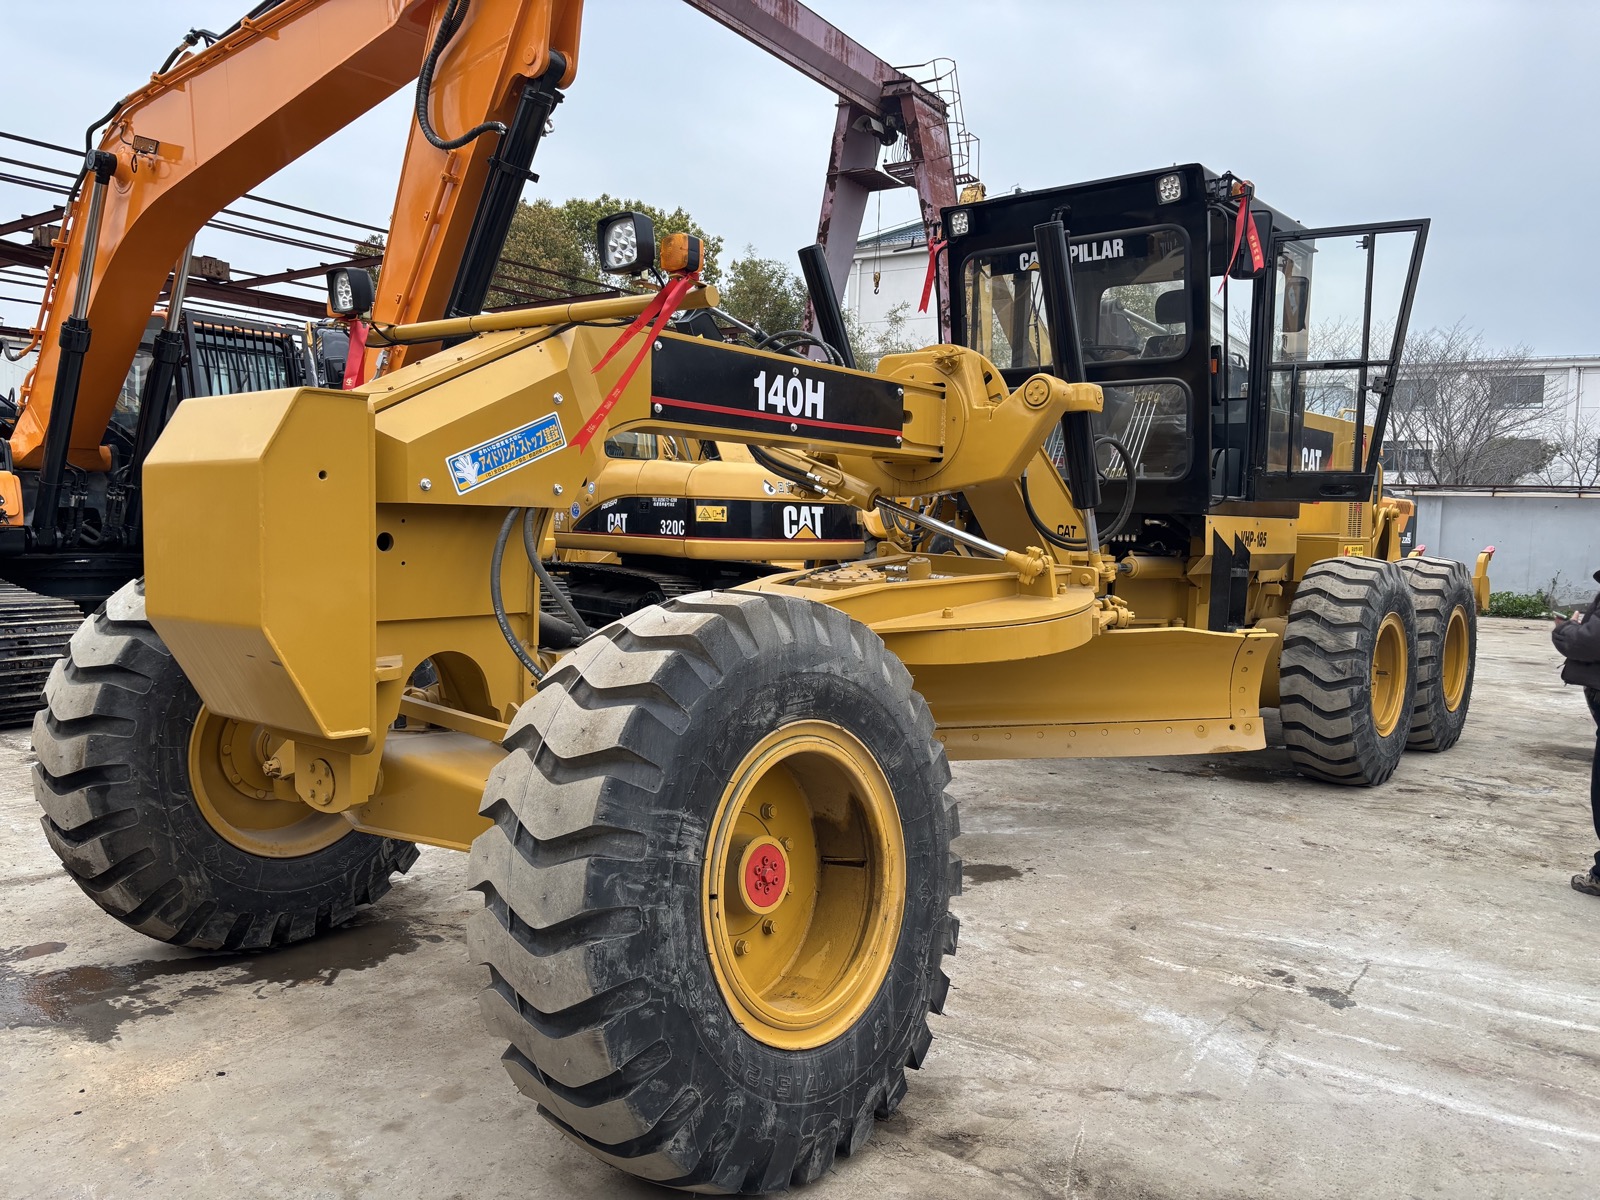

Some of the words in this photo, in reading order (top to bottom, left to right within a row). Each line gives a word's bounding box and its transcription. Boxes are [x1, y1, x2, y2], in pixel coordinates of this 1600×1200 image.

[1019, 238, 1124, 271] CAPILLAR
[753, 370, 825, 420] 140H
[1301, 447, 1322, 471] CAT
[607, 513, 628, 534] CAT
[660, 519, 685, 535] 320C
[783, 505, 824, 540] CAT
[1057, 524, 1077, 538] CAT
[1240, 530, 1268, 548] VHP-185
